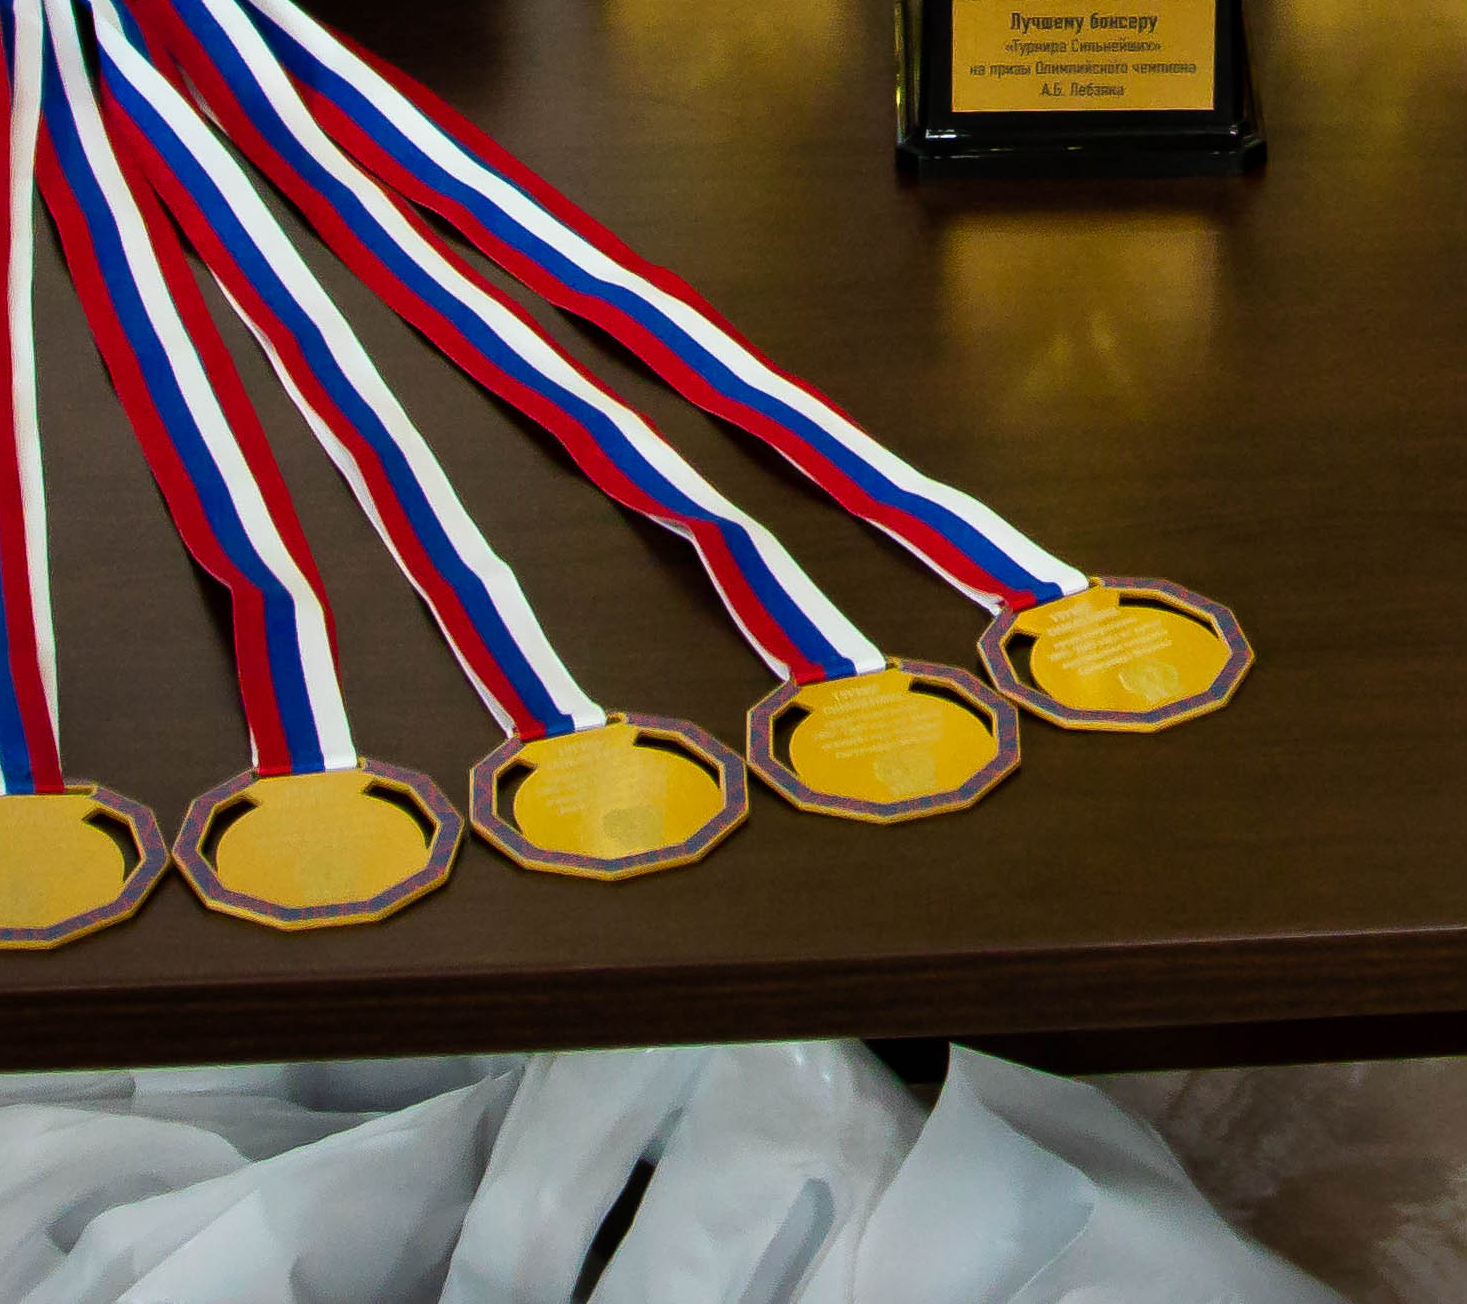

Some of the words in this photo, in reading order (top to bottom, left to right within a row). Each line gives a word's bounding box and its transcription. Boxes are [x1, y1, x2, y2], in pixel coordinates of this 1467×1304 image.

[1009, 12, 1084, 34] Лучшему
[1090, 12, 1158, 34] боксеру
[1005, 38, 1067, 56] «Турнира
[1071, 36, 1162, 53] Сильнейших»
[969, 64, 986, 76] на
[990, 64, 1031, 78] призы
[1035, 59, 1128, 75] Олимпийского
[1132, 62, 1197, 75] чемпиона
[1040, 83, 1066, 97] А.Б.
